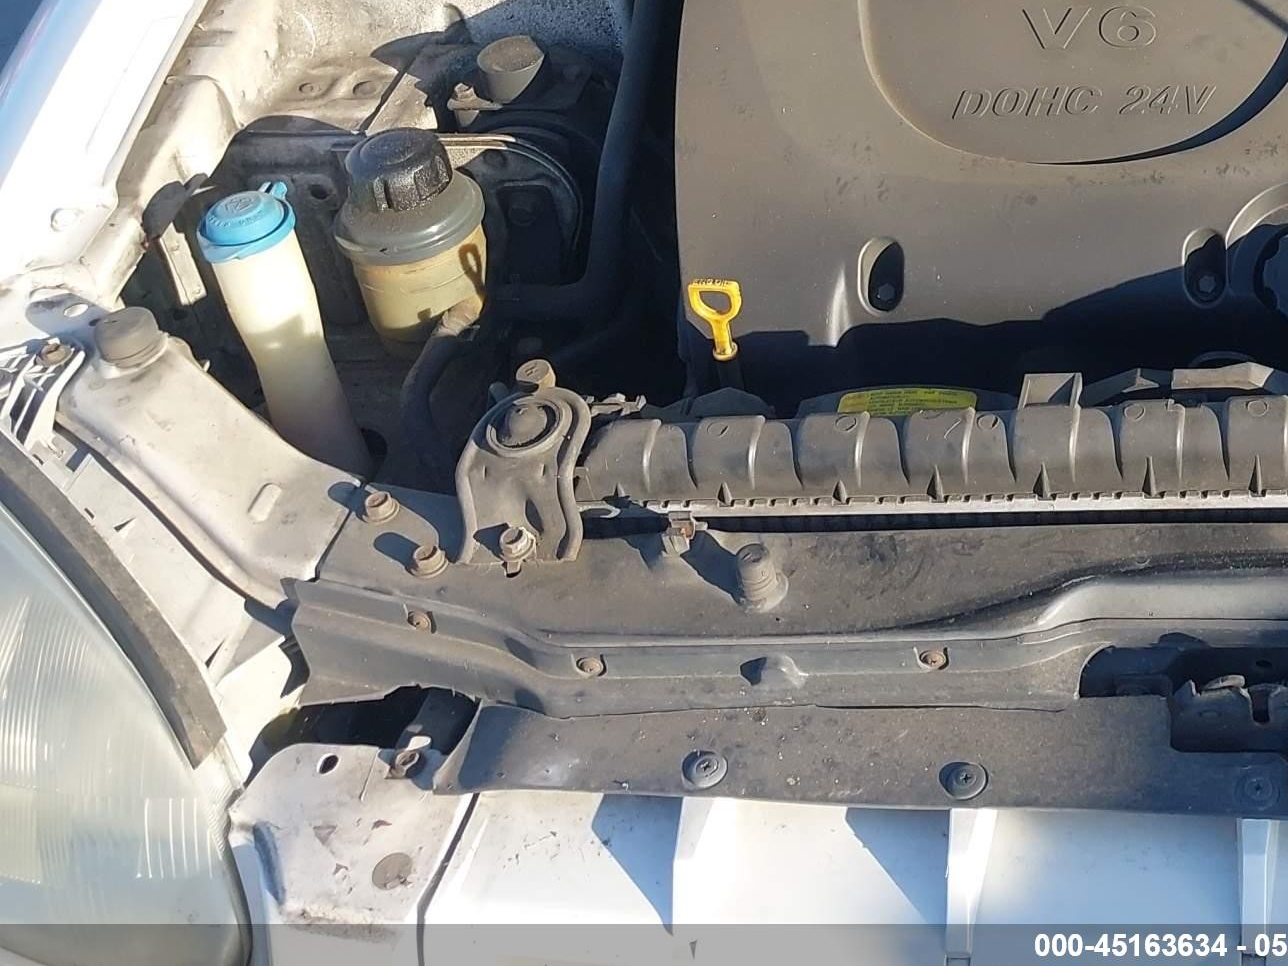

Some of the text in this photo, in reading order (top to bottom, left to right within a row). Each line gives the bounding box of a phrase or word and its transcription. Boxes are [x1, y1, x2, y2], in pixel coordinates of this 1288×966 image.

[1021, 5, 1157, 50] V6
[951, 84, 1217, 120] DOHC 24V
